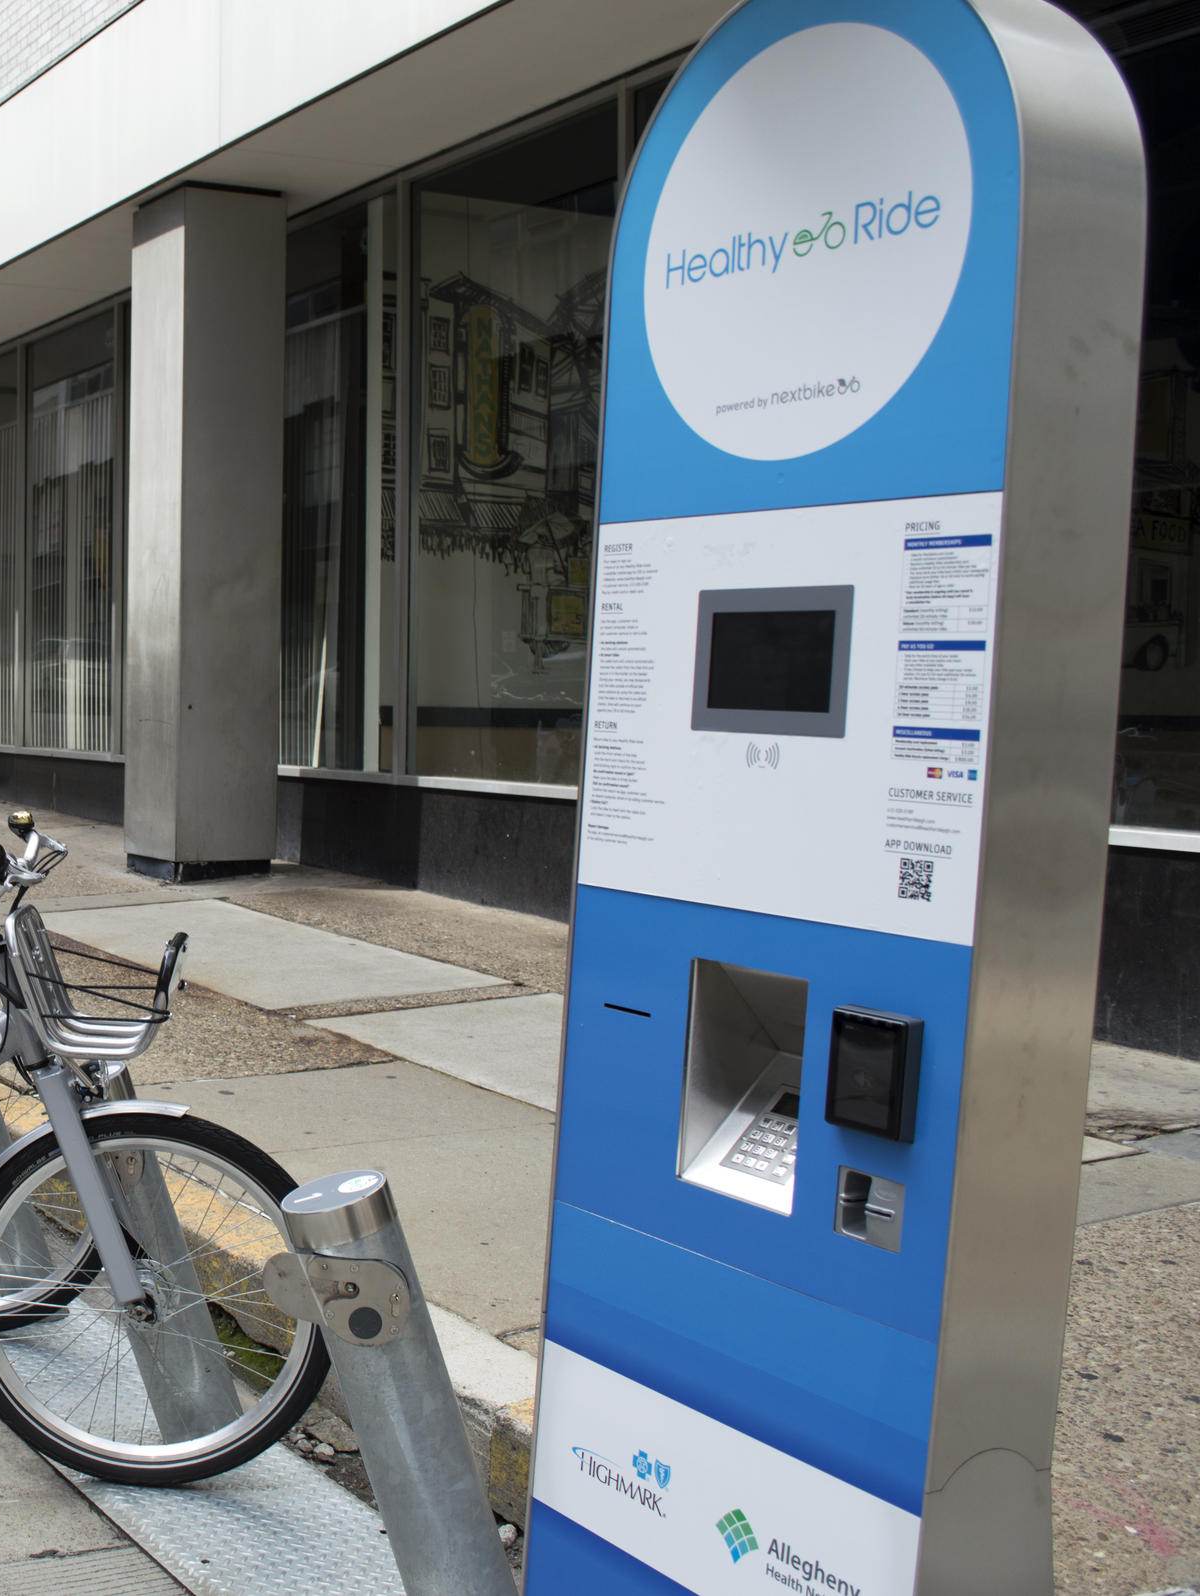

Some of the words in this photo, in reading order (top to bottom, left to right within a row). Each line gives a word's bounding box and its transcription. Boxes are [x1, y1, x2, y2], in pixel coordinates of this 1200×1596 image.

[666, 231, 789, 289] Healthy
[854, 190, 941, 245] Ride
[715, 398, 755, 416] powered
[757, 396, 768, 408] by
[771, 380, 835, 405] nextbike
[905, 521, 941, 532] PRICING
[604, 543, 632, 552] REGISTER
[601, 603, 623, 611] RENTAL
[594, 720, 617, 729] RETURN
[947, 770, 963, 778] VISA
[888, 787, 934, 800] CUSTOMER
[936, 791, 973, 803] SERVICE
[885, 839, 901, 849] APP
[904, 840, 952, 855] DOWNLOAD
[580, 1450, 664, 1518] HIGHMARK
[768, 1538, 860, 1596] Allegheny
[765, 1563, 803, 1594] Health
